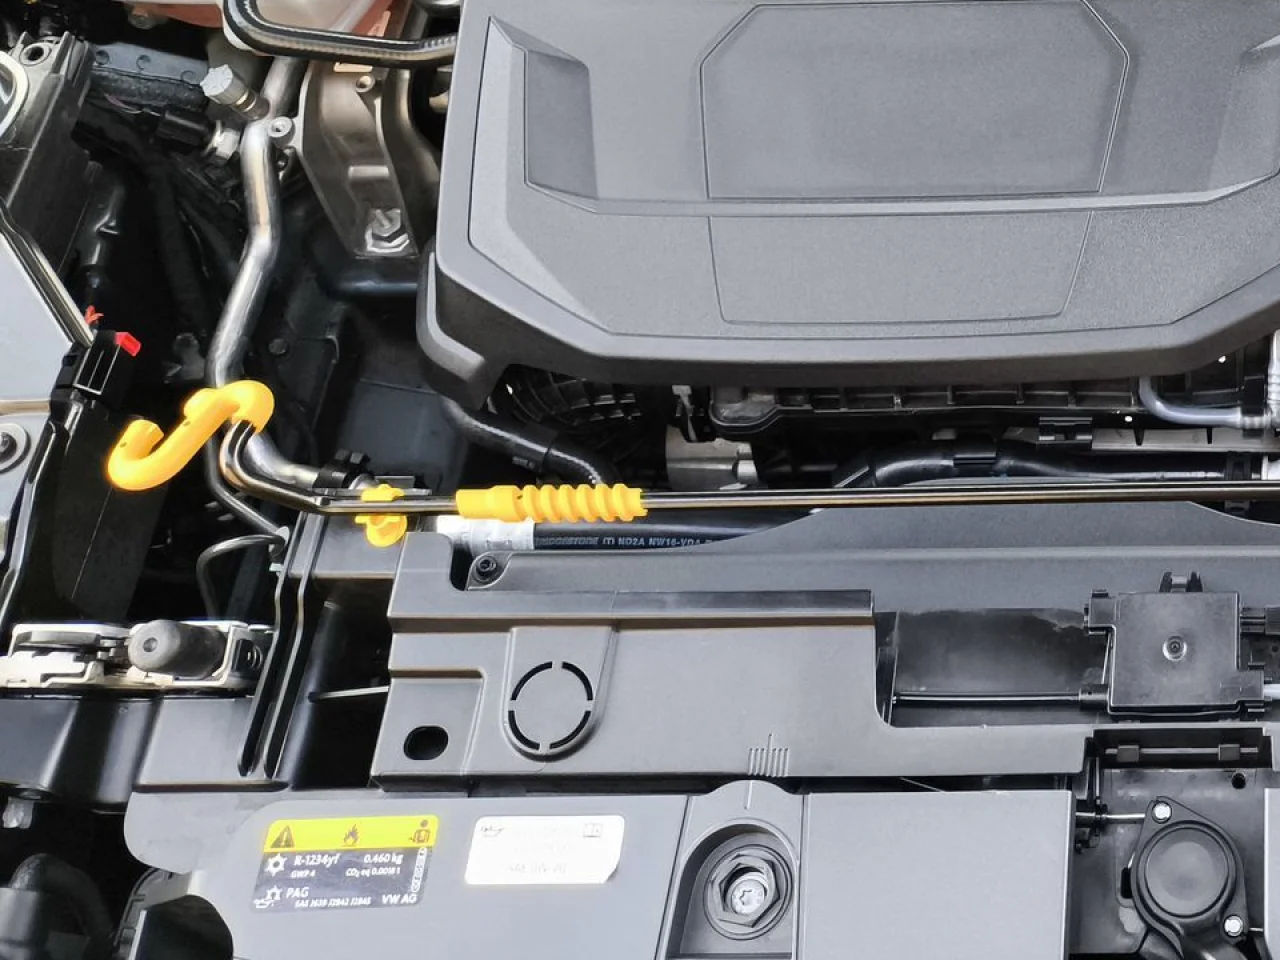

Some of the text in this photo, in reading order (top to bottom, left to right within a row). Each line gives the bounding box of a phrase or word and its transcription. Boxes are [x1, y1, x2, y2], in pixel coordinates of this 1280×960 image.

[293, 853, 404, 869] R-1234yf 0.460 kg
[285, 887, 309, 898] PAG
[381, 894, 418, 905] VW AG
